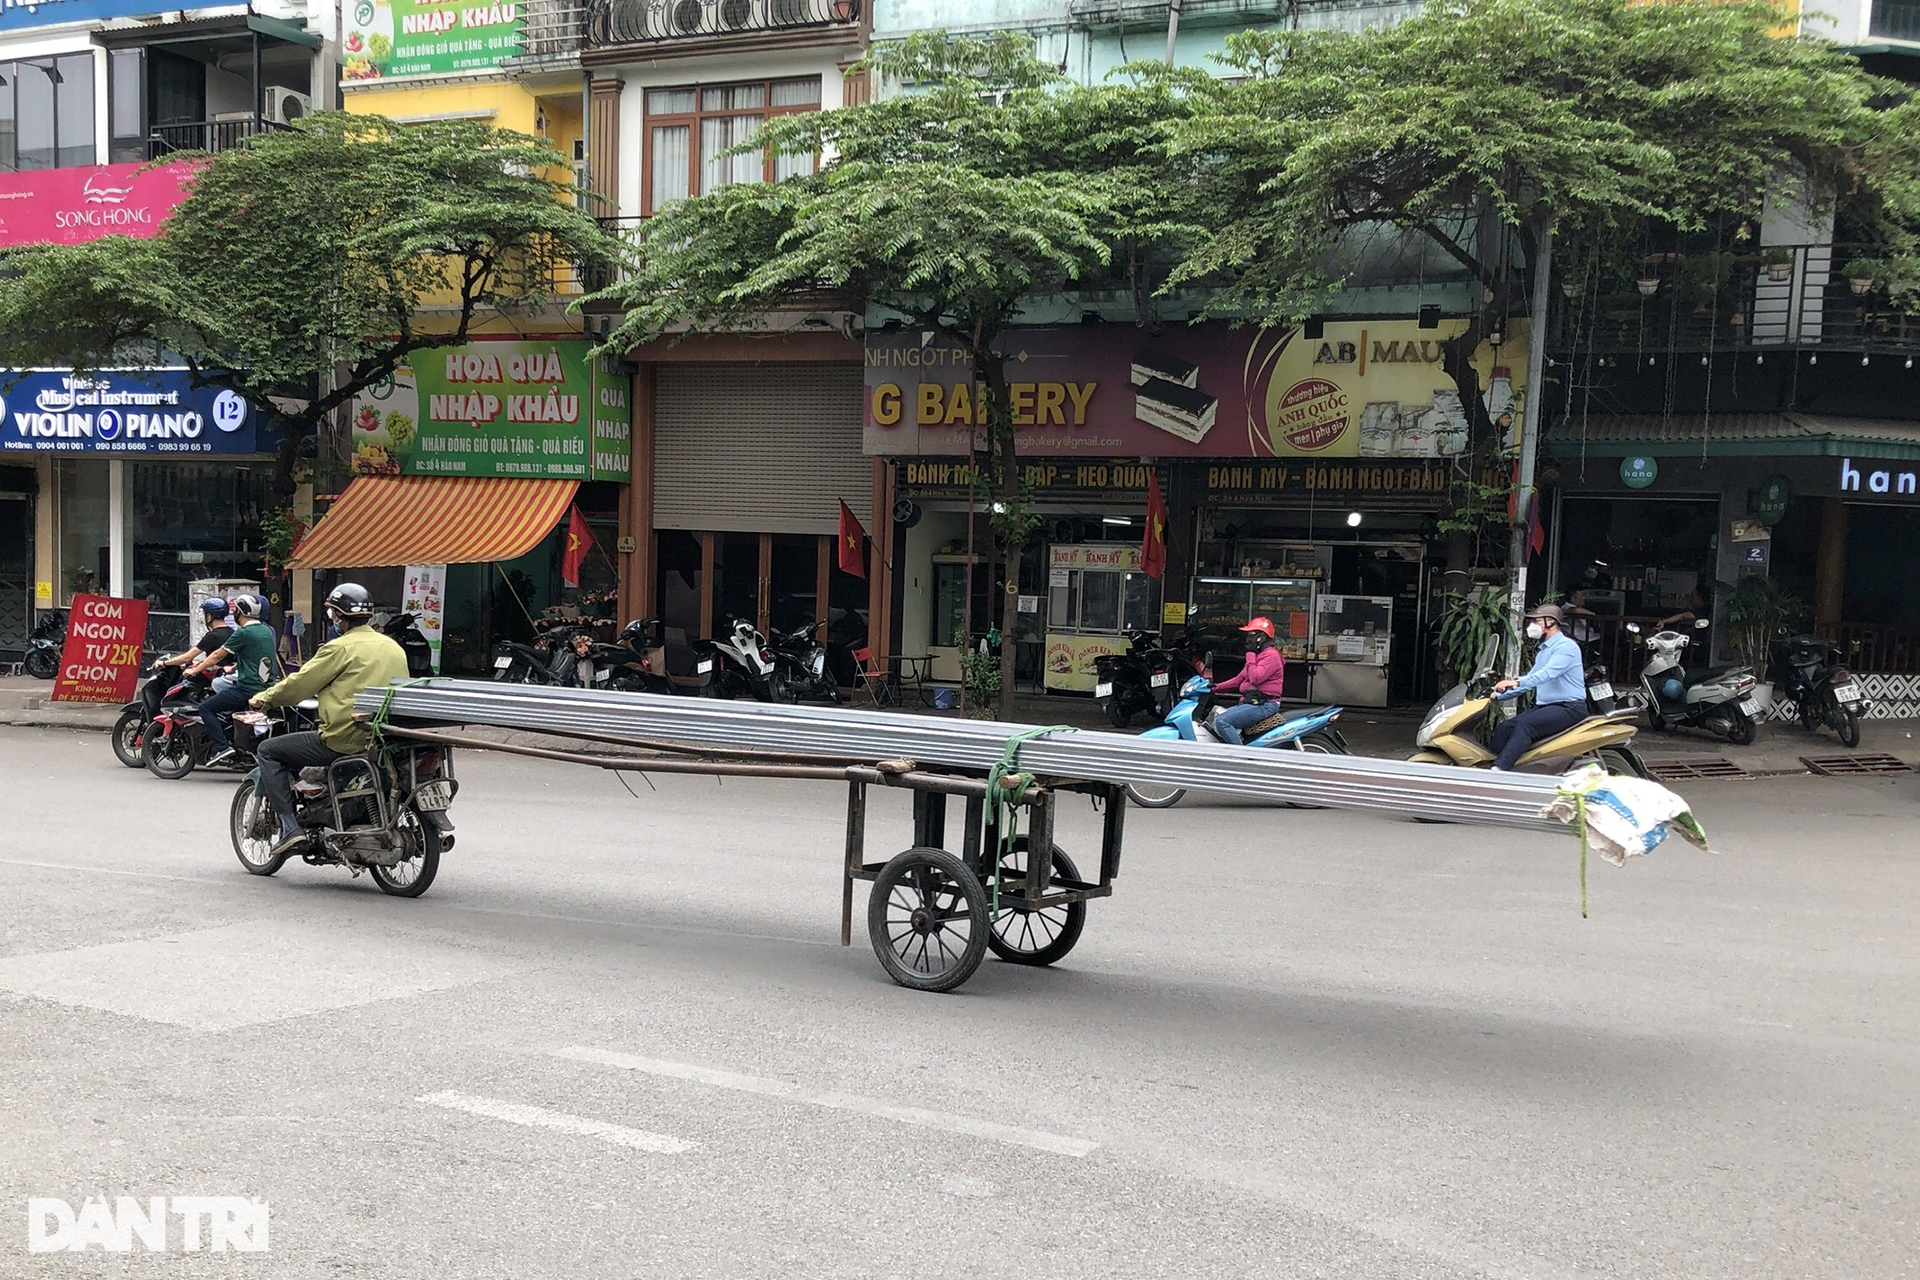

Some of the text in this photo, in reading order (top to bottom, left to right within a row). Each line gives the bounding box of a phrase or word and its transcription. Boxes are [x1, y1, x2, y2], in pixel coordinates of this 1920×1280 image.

[402, 9, 457, 35] NHẬP
[893, 347, 949, 369] NGỌT
[1313, 340, 1357, 364] AB
[445, 346, 565, 385] HOA QUẢ
[219, 401, 239, 421] 12
[429, 385, 580, 429] NHẬP KHẨU
[1276, 392, 1349, 429] ANH QUỐC
[13, 412, 204, 438] VIOLIN PIANO
[597, 419, 629, 444] NHẬP
[4, 440, 212, 451] Hotline: 0904 061 061 090 858 6666 0983 99 66 19
[421, 434, 446, 455] NHẬN
[490, 436, 508, 455] QUÀ
[510, 437, 534, 457] TẶNG
[542, 437, 561, 456] QUÀ
[563, 434, 584, 456] BIẾU
[1293, 433, 1311, 446] men
[435, 459, 441, 471] 4
[596, 448, 630, 472] KHẨU
[907, 459, 949, 485] BÁNH
[1076, 464, 1106, 487] HEO
[1624, 469, 1653, 478] hana
[1751, 548, 1761, 557] 2
[270, 592, 280, 604] 8
[1005, 580, 1018, 594] 6
[83, 601, 122, 619] CƠM
[73, 621, 126, 641] NGON
[85, 643, 140, 666] TỰ 25K
[65, 664, 118, 683] CHỌN
